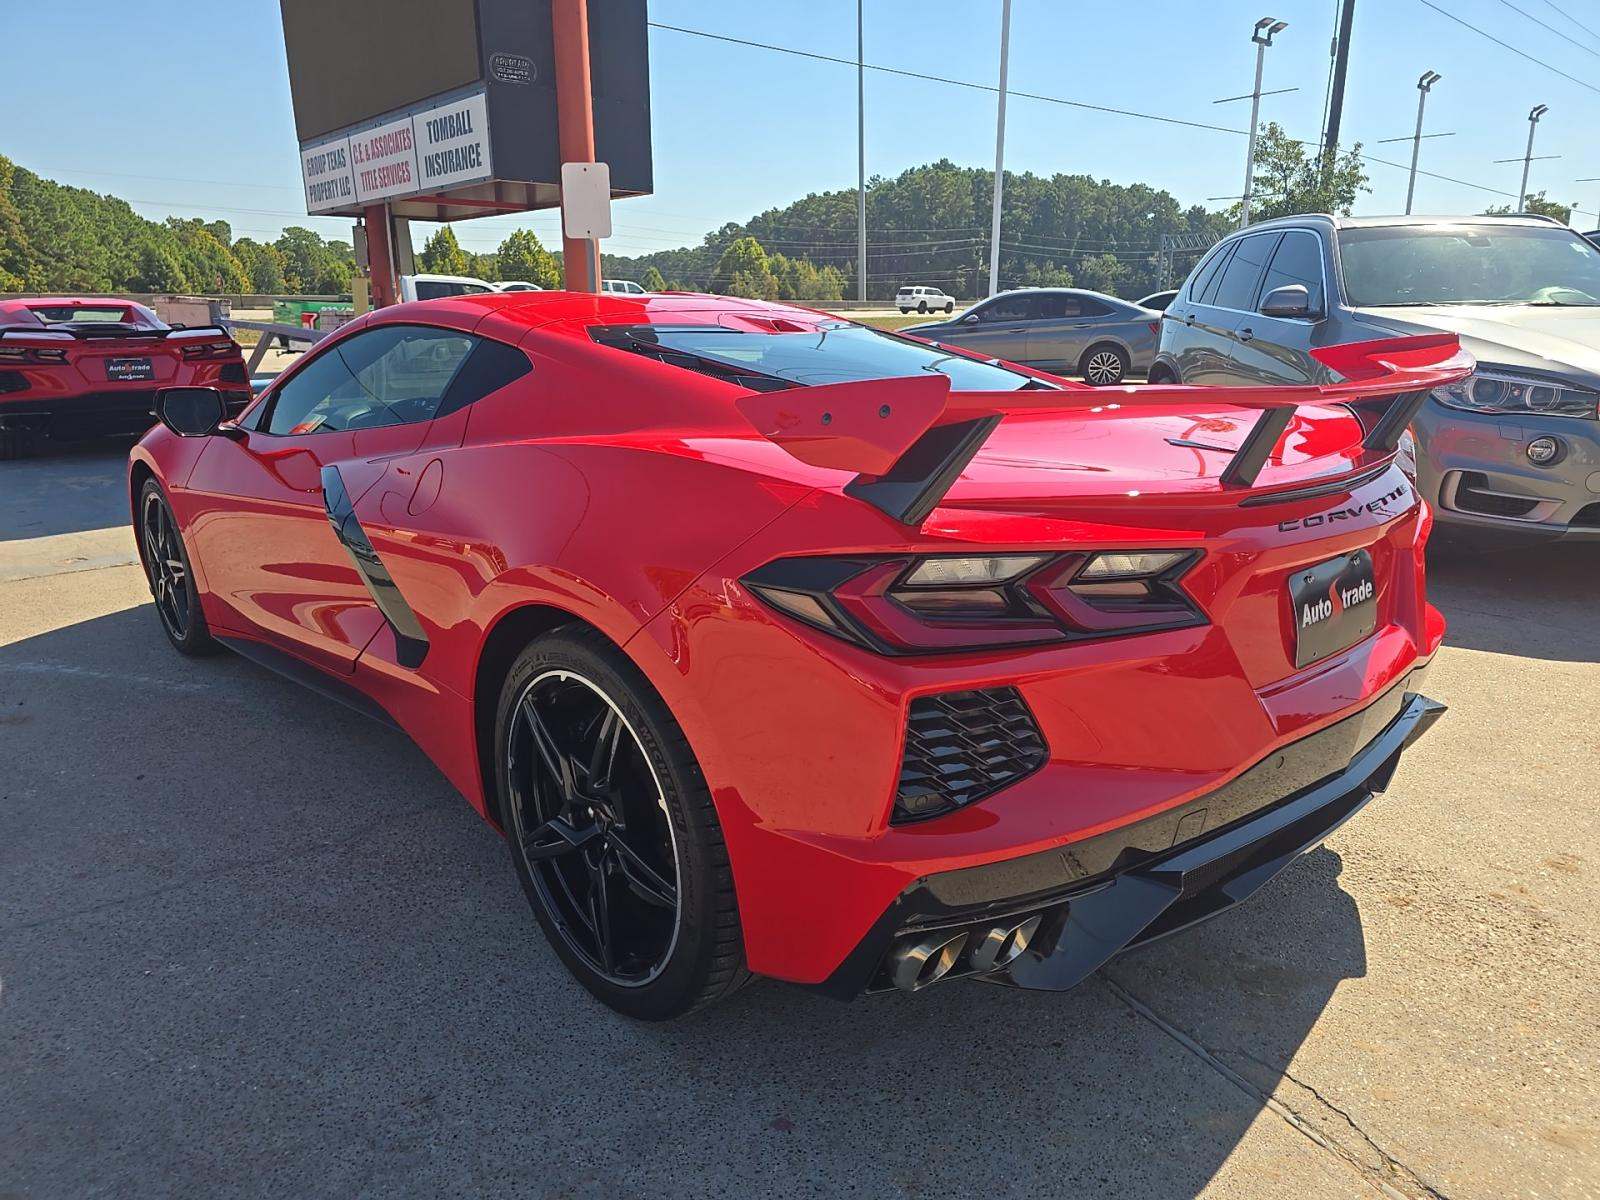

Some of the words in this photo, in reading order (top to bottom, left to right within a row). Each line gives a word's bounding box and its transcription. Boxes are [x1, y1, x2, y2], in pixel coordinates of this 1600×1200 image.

[426, 109, 473, 144] TOMBALL
[306, 153, 326, 177] GROUP
[326, 148, 346, 171] TEXAS
[352, 144, 364, 165] C.E.
[364, 144, 371, 161] &
[370, 127, 412, 159] ASSOCIATES
[425, 143, 482, 178] INSURANCE
[309, 178, 339, 203] PROPERTY
[339, 176, 351, 197] LLC
[360, 169, 379, 192] TITLE
[378, 160, 411, 188] SERVICES
[1278, 484, 1408, 532] CORVETTE
[638, 724, 687, 833] MICHELIN
